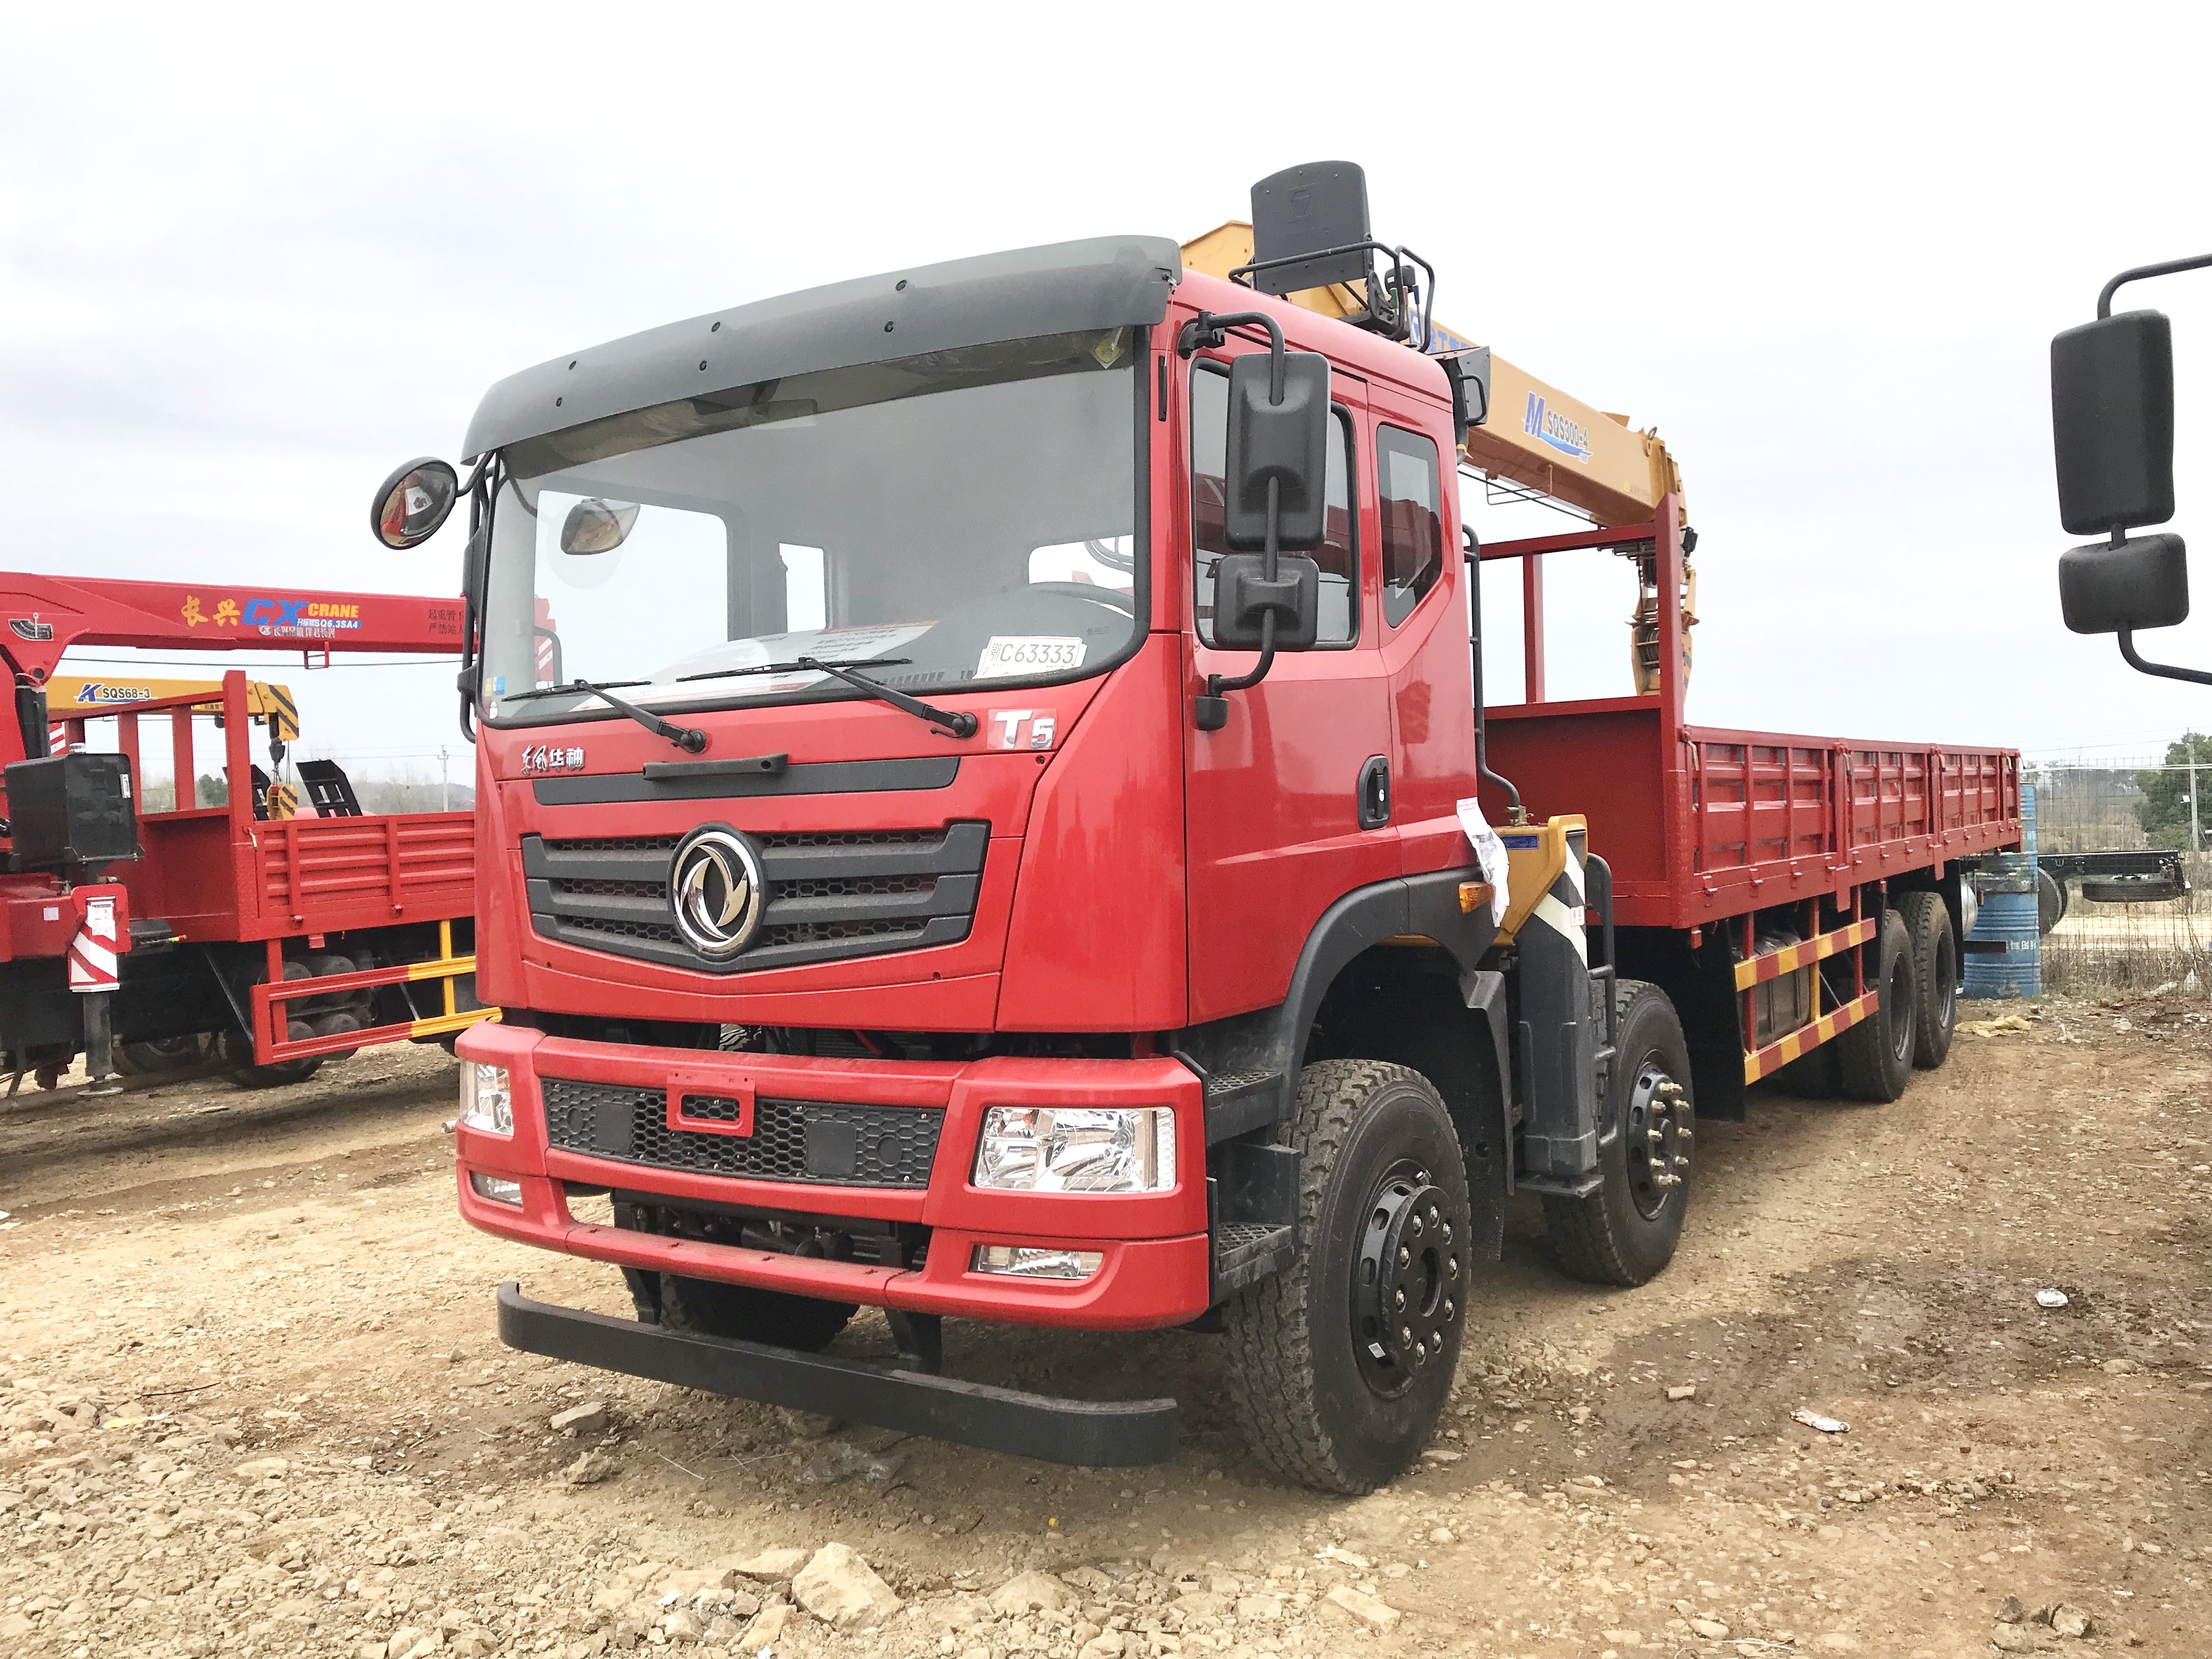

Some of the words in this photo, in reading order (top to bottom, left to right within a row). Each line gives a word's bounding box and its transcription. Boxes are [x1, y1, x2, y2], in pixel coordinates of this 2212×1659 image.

[181, 595, 241, 627] 长兴
[241, 599, 309, 626] CX
[308, 603, 359, 618] CRANE
[103, 687, 150, 699] SQS68-3
[995, 710, 1055, 750] T5
